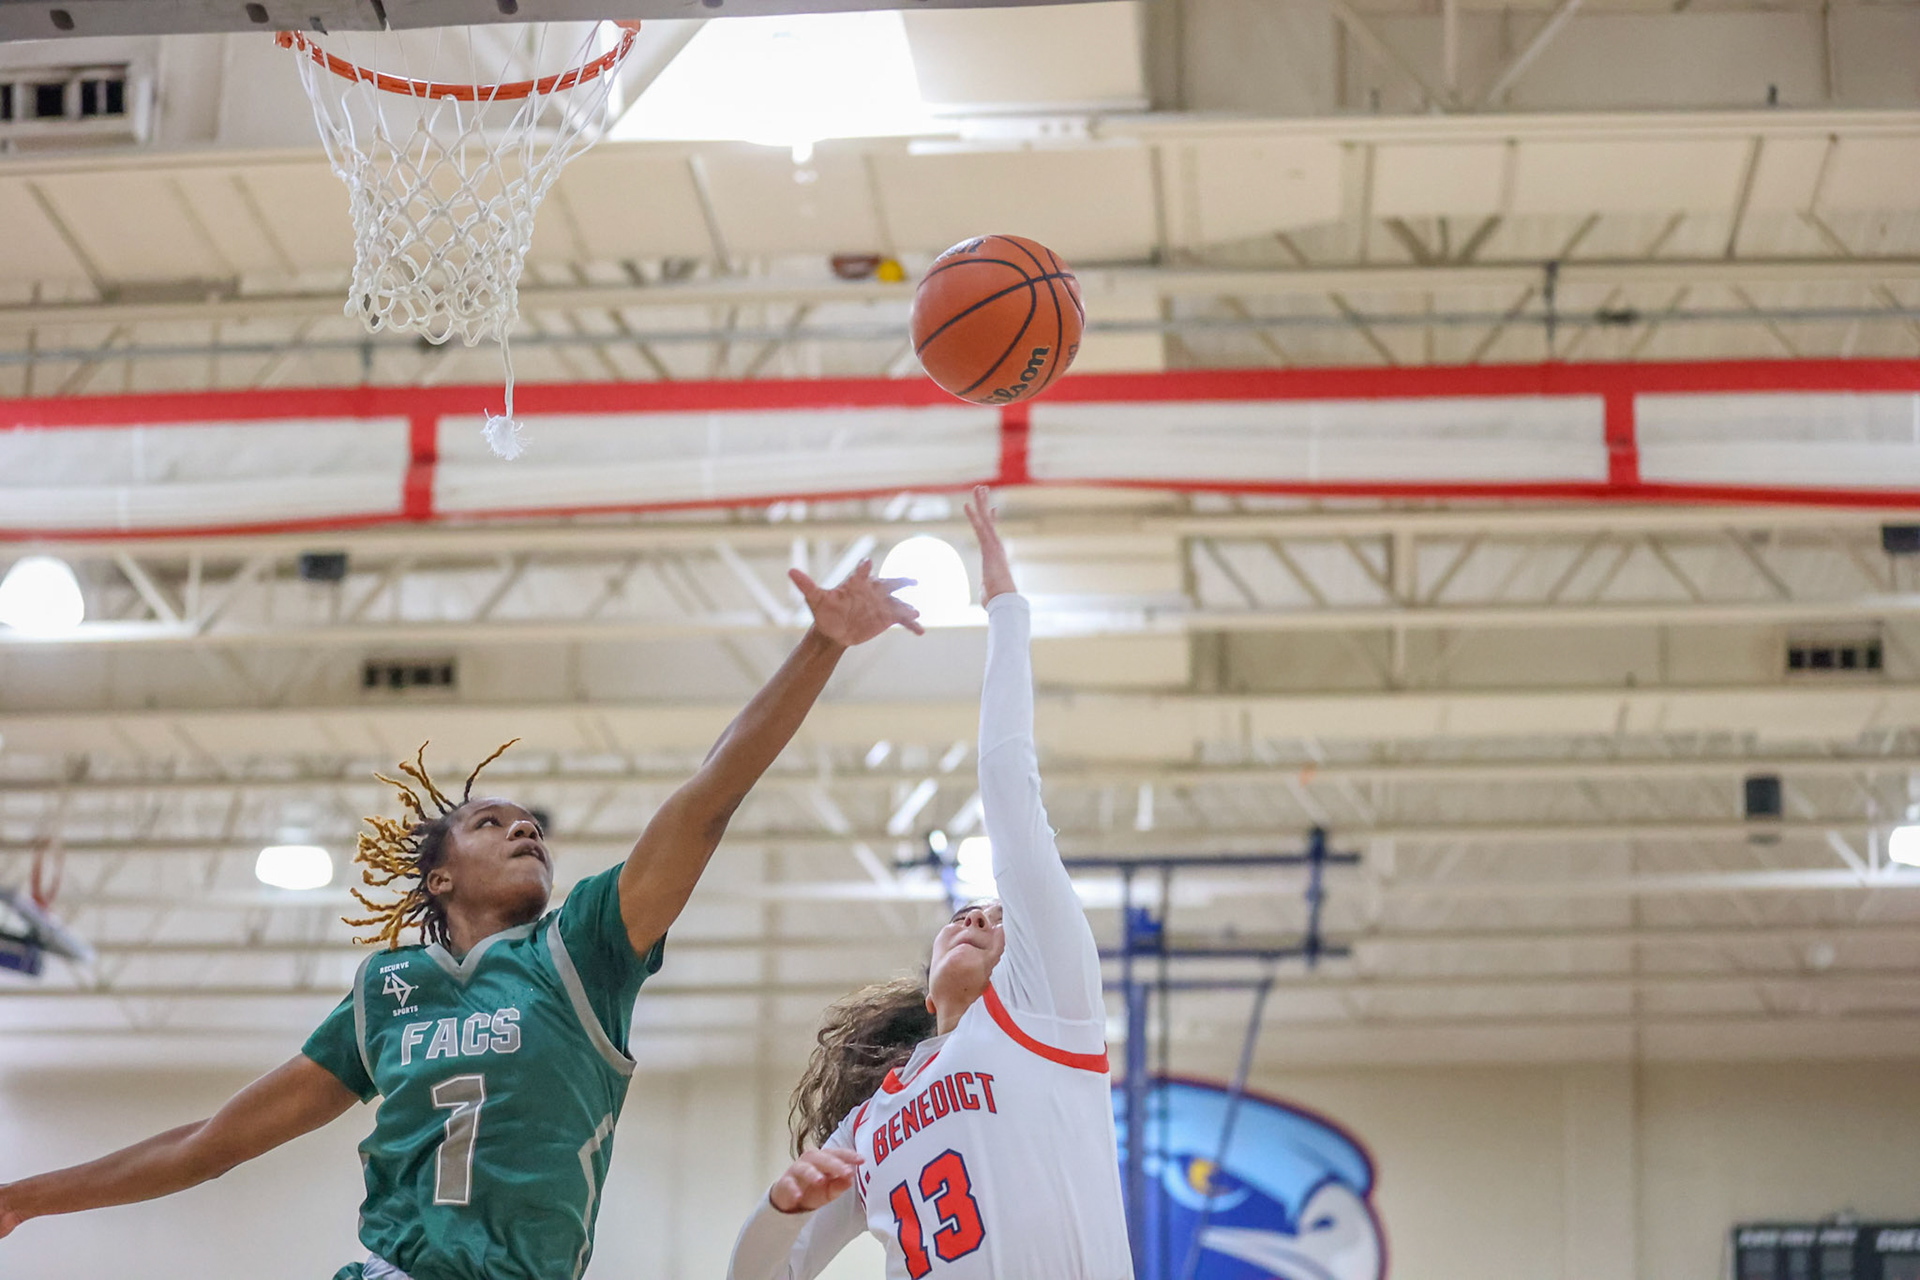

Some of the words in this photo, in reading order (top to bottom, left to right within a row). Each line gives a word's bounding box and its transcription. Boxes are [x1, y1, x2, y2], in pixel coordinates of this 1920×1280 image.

[379, 960, 410, 974] RECURVE
[392, 1005, 419, 1017] SPORTS
[401, 1008, 521, 1066] FACS
[873, 1071, 997, 1166] BENEDICT
[889, 1148, 986, 1280] 13
